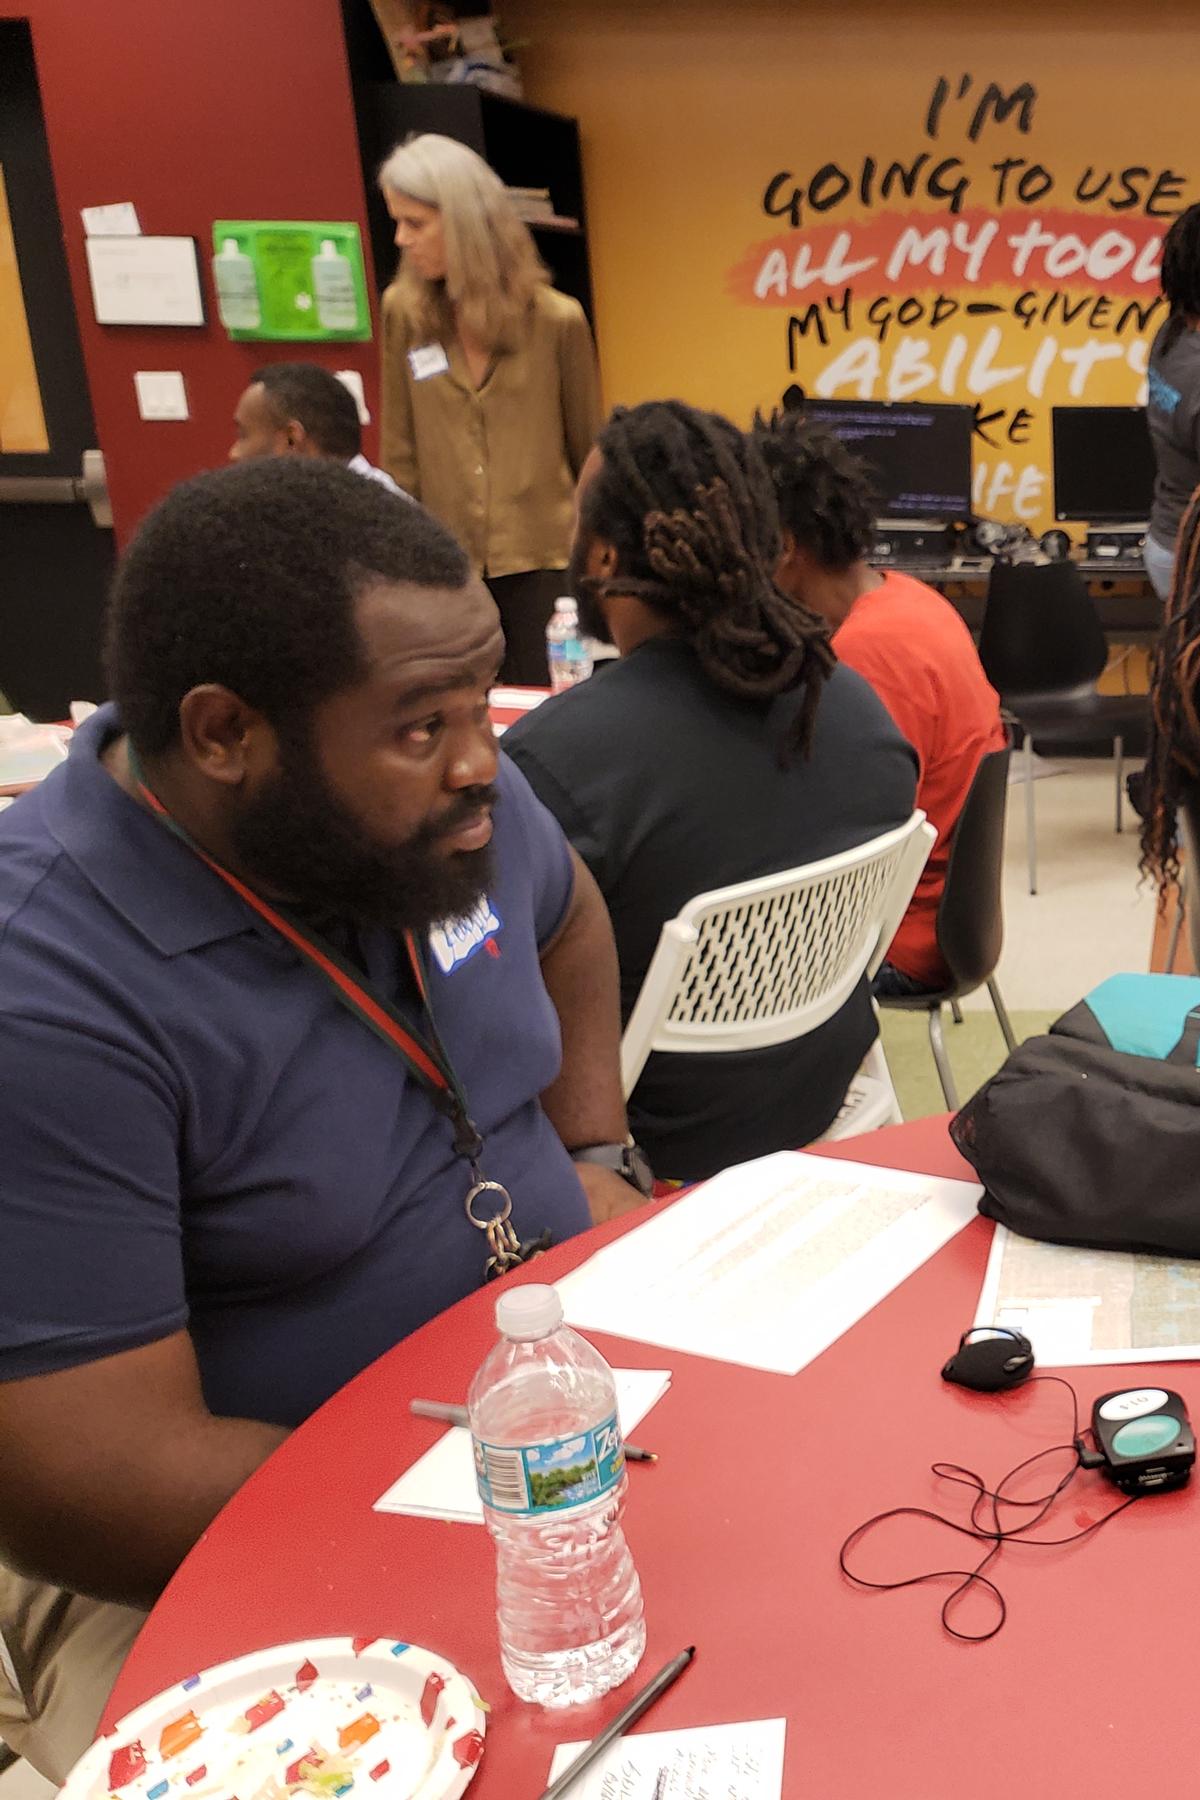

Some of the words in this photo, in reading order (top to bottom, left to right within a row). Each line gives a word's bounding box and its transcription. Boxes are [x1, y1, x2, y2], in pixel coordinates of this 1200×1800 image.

[926, 73, 1037, 142] I'M
[763, 153, 971, 227] GOING
[992, 157, 1053, 206] TO
[1075, 166, 1187, 217] USE
[754, 231, 880, 298] ALL
[885, 219, 998, 282] MY
[787, 286, 853, 377] MY
